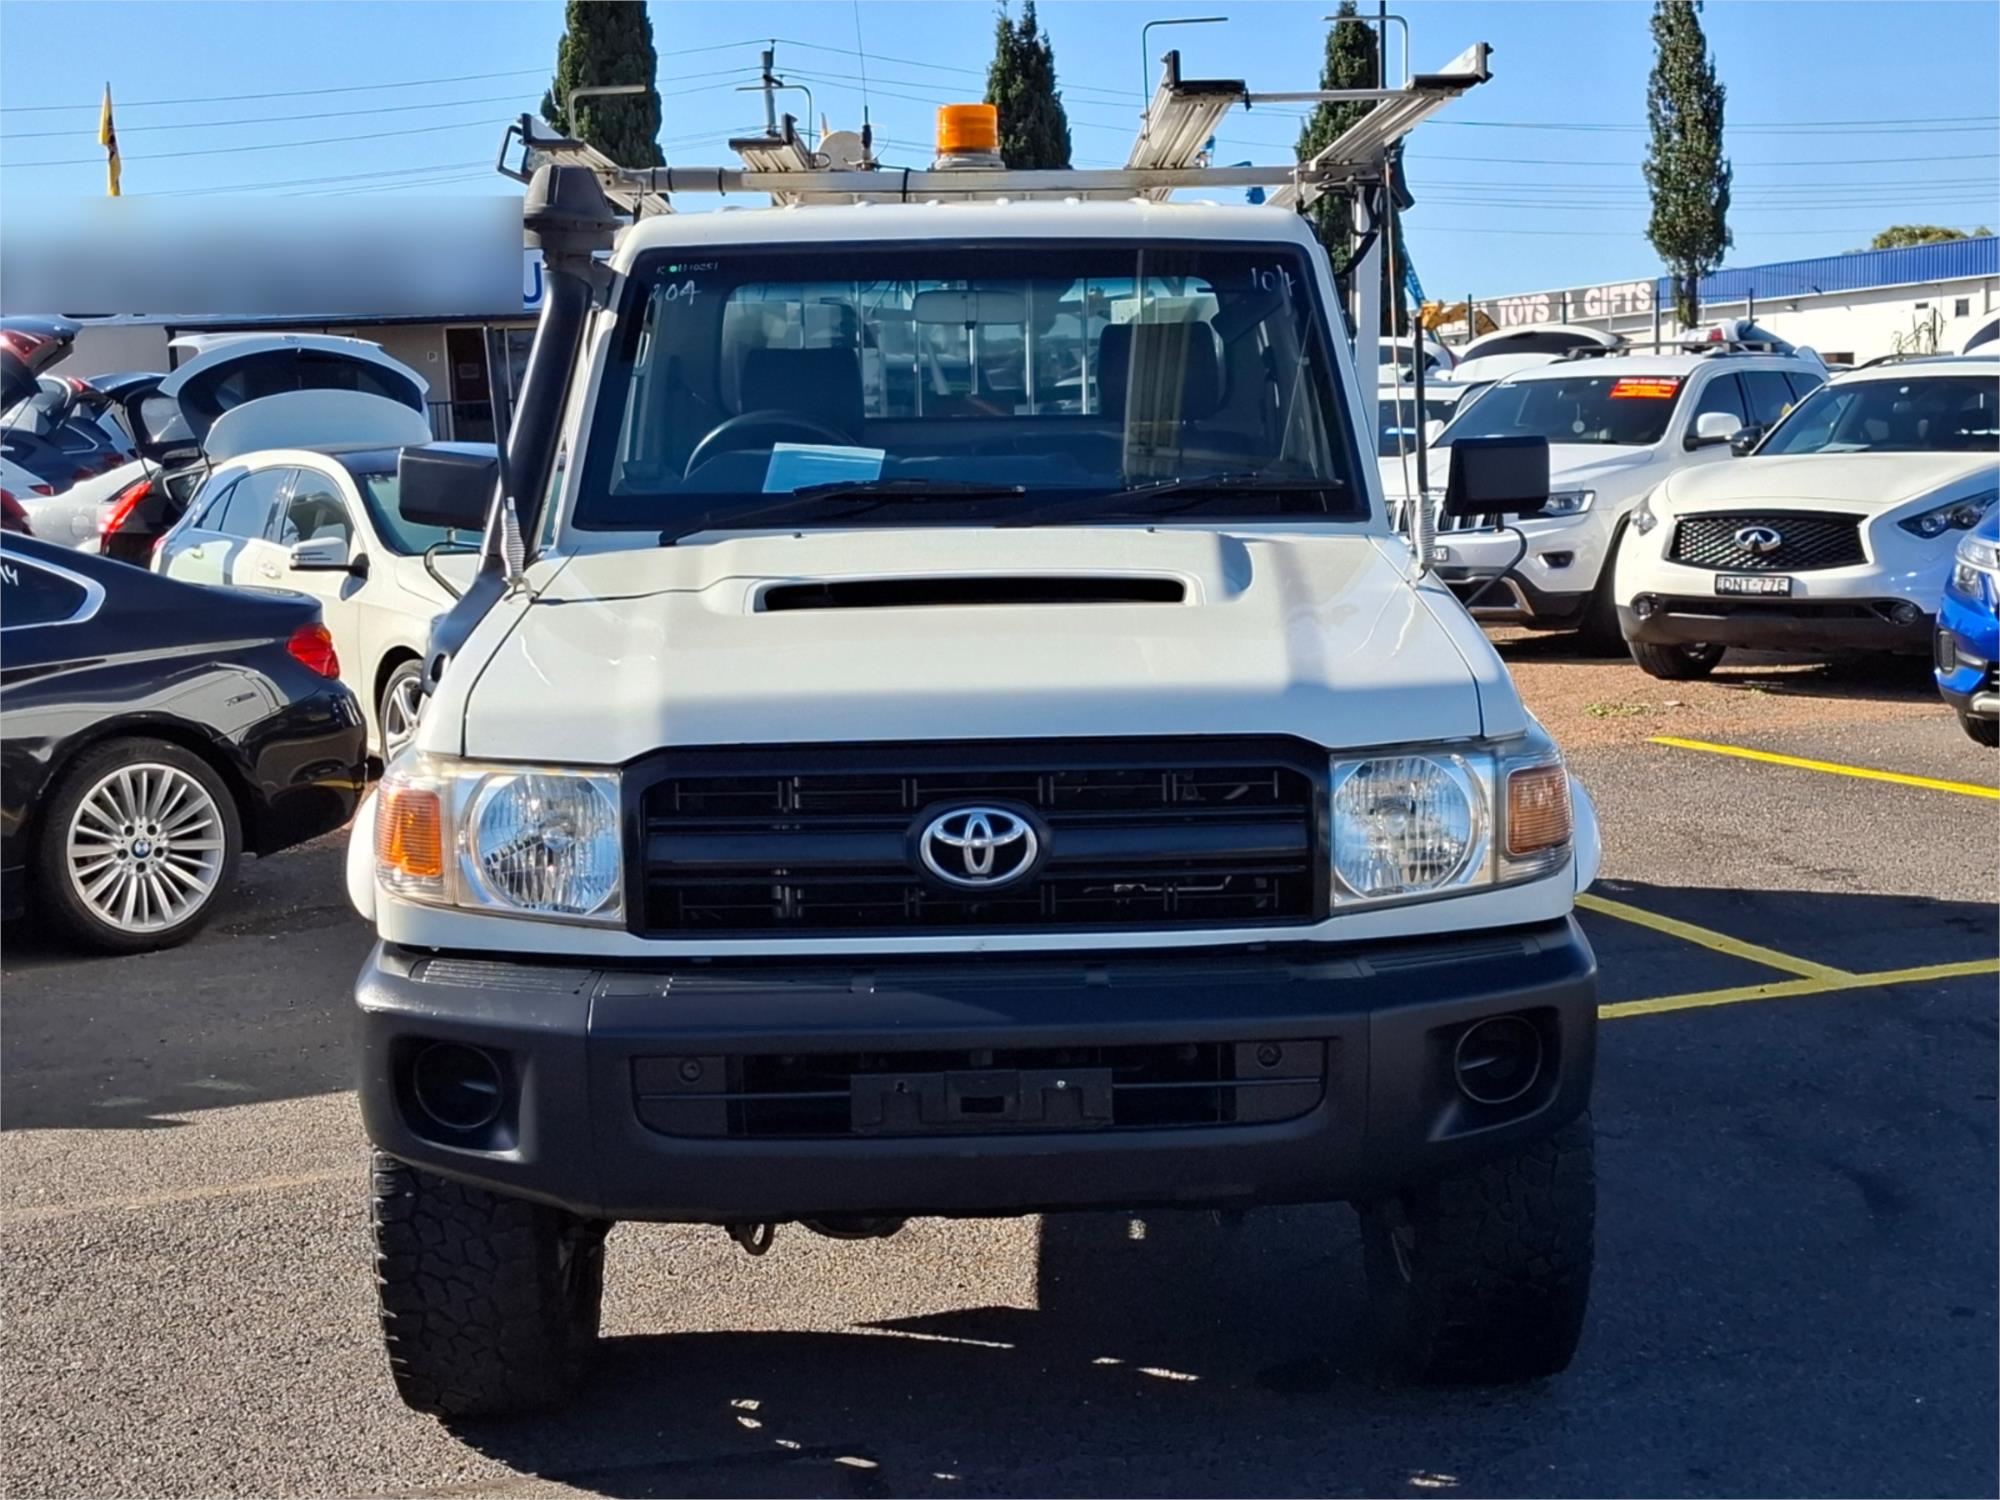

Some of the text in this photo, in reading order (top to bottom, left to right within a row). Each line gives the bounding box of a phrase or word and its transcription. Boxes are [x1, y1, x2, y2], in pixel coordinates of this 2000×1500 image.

[1250, 264, 1296, 297] 104
[1497, 294, 1550, 327] TOYS
[1584, 281, 1652, 317] GIFTS
